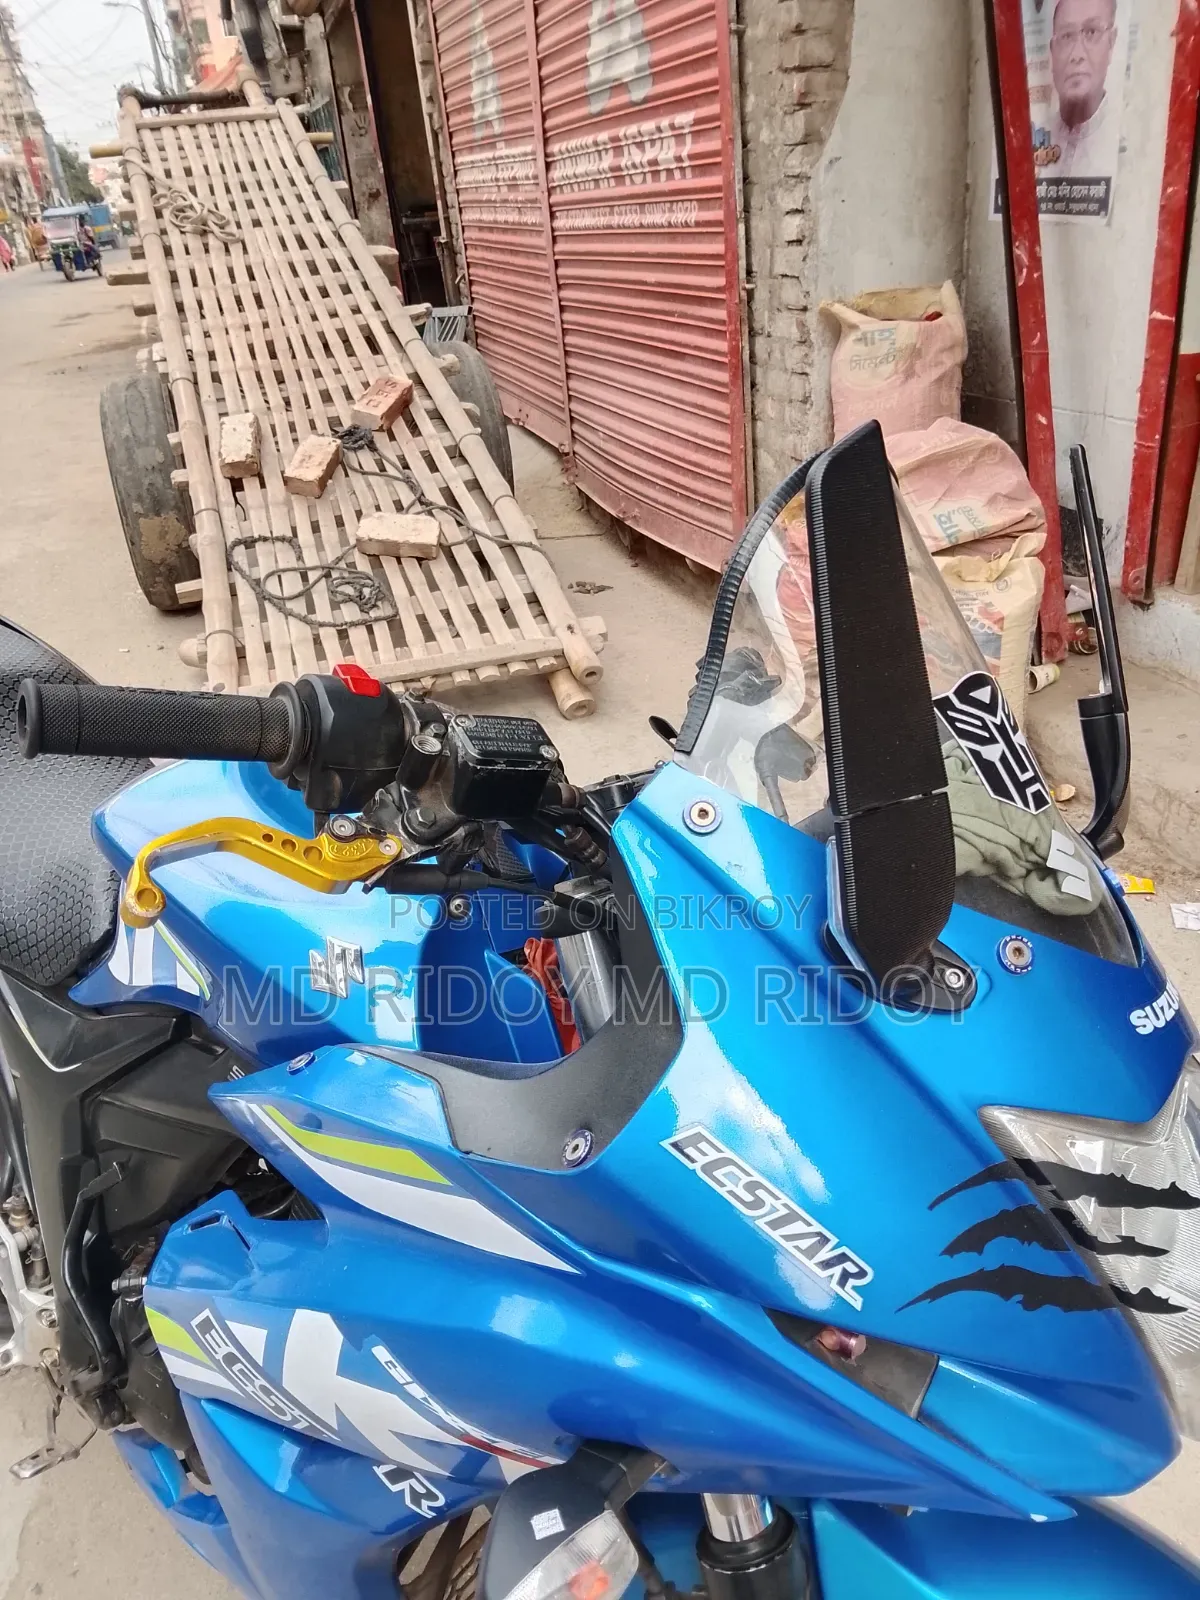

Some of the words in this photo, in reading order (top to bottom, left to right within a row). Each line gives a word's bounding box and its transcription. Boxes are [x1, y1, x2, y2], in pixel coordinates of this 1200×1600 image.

[619, 111, 697, 186] ISPAT
[612, 204, 641, 229] STEEL
[642, 202, 671, 228] SINCE
[671, 200, 699, 228] 1978
[1130, 977, 1180, 1035] SUZU
[660, 1127, 873, 1310] ECSTAR
